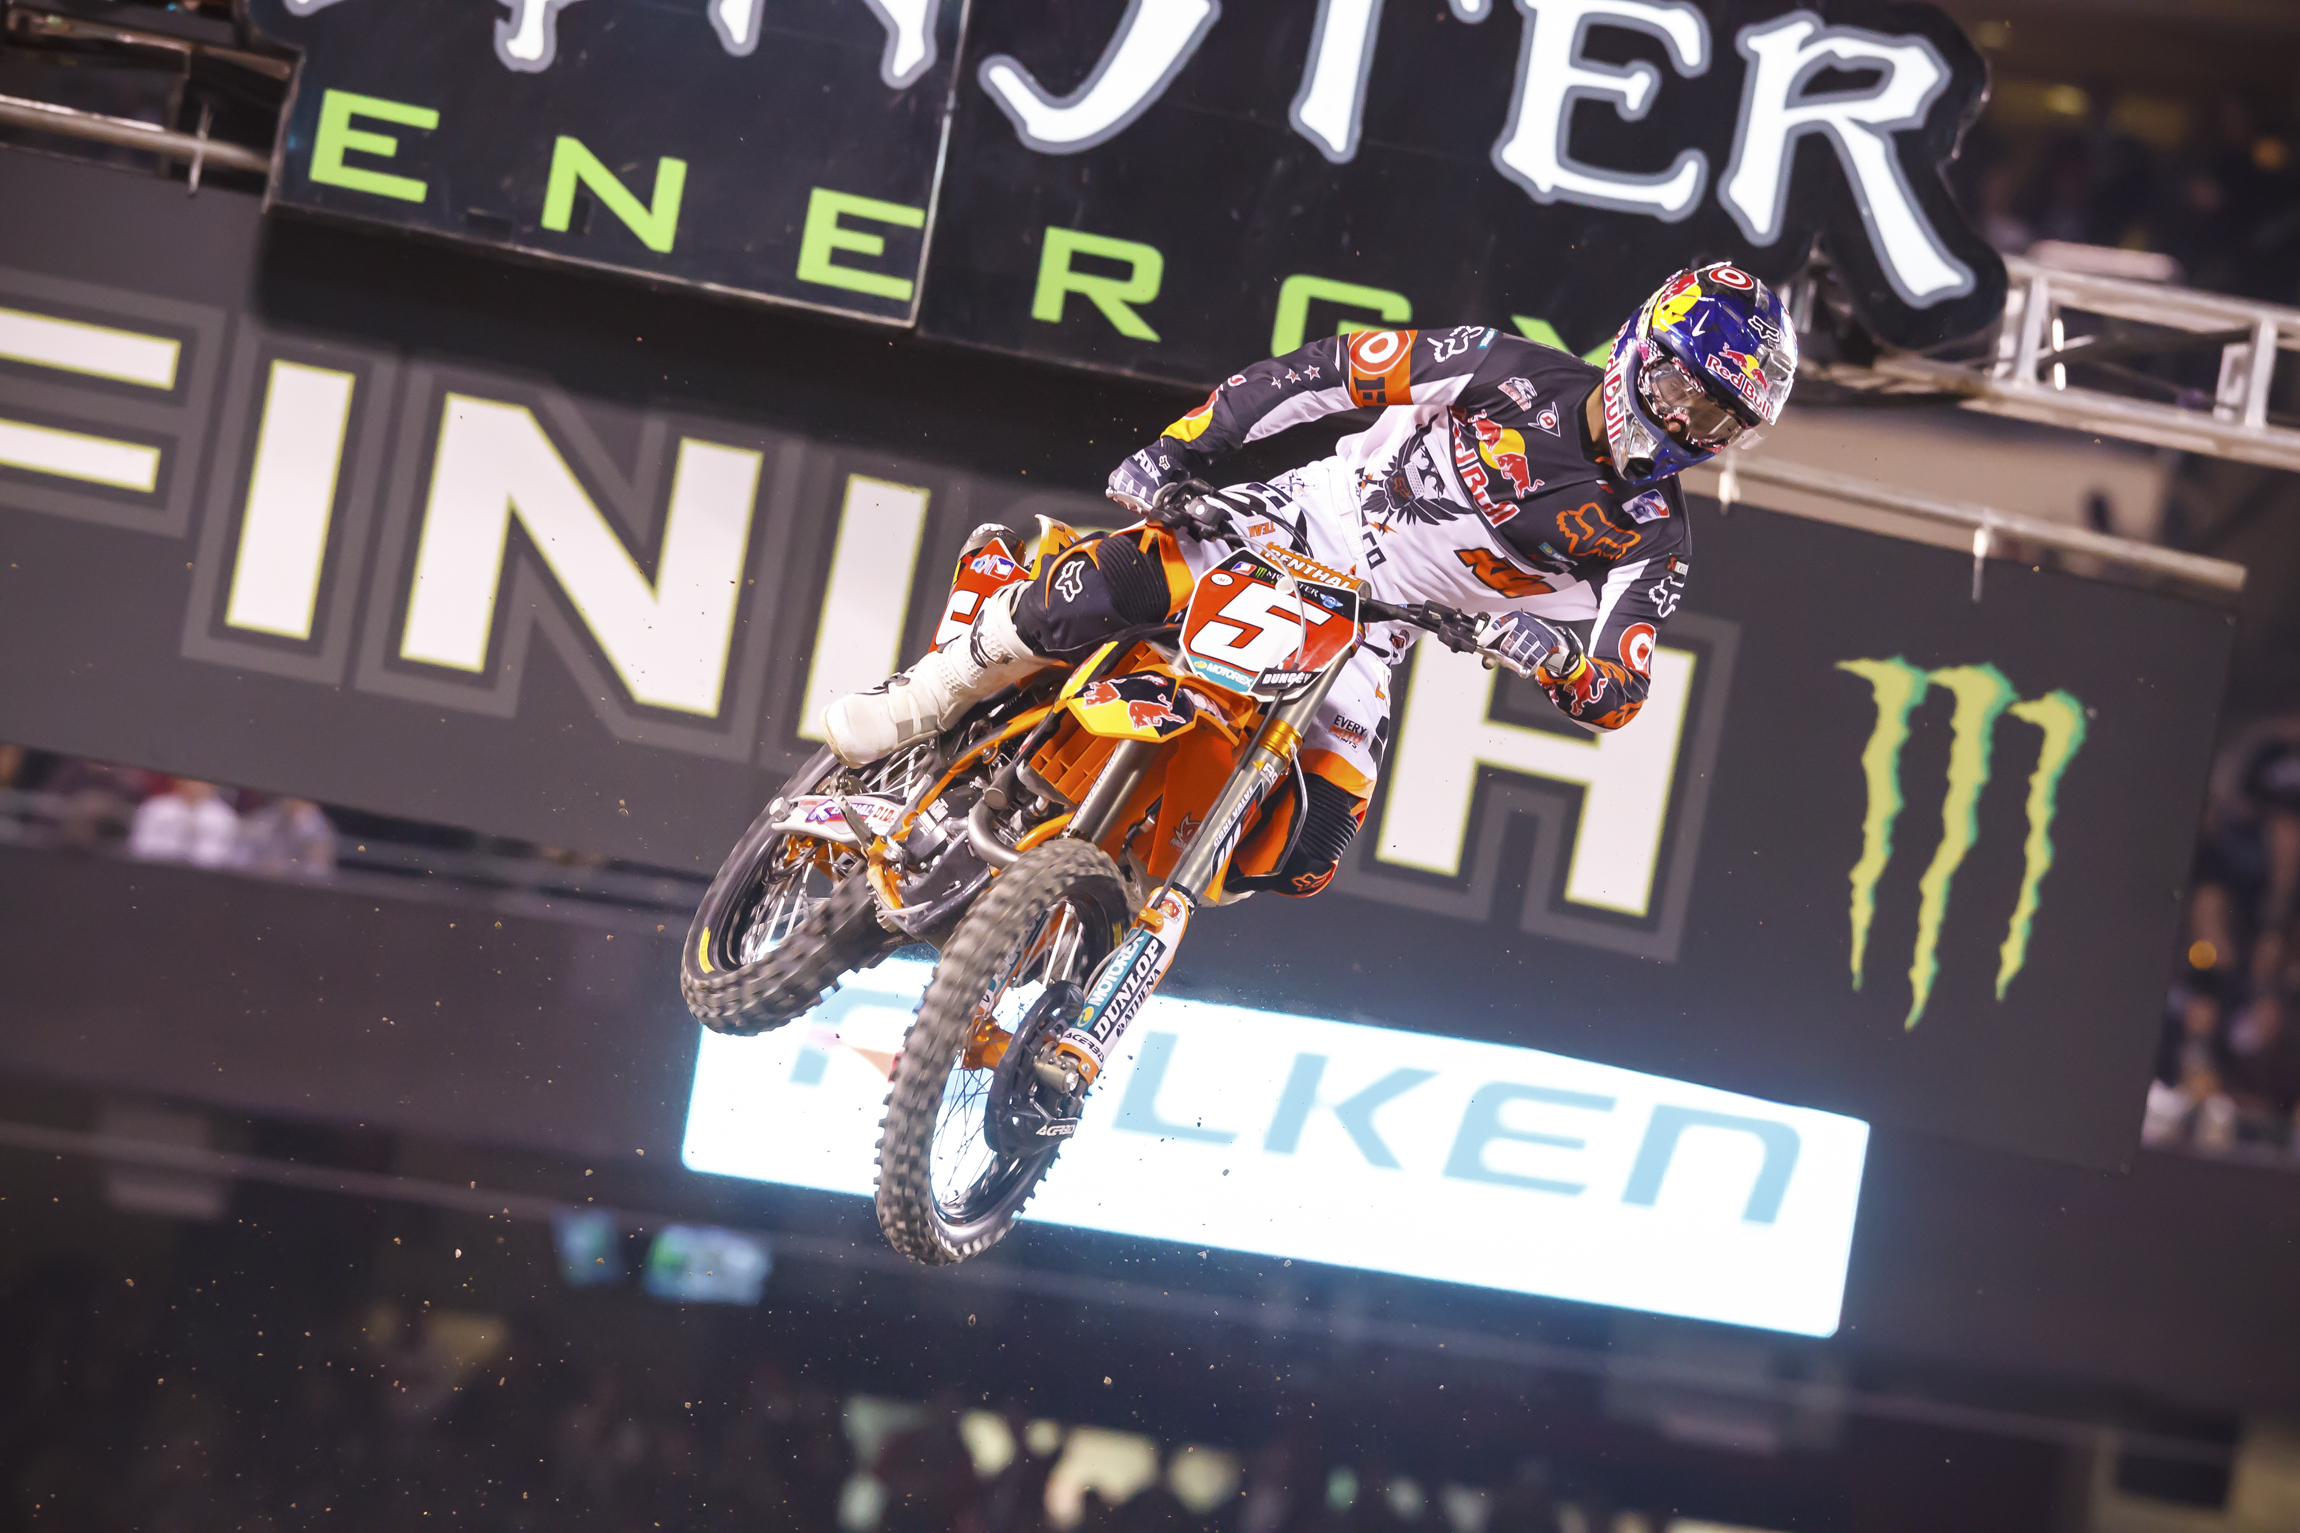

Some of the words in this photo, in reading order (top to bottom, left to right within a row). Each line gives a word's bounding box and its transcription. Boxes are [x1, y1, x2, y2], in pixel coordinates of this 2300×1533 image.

[0, 309, 1698, 917] FINIH
[1189, 581, 1335, 672] 5
[1206, 662, 1254, 688] MOTOREX
[1333, 714, 1367, 736] EVERY
[1094, 938, 1161, 1041] DUNLOP
[789, 985, 1801, 1226] FLKEN
